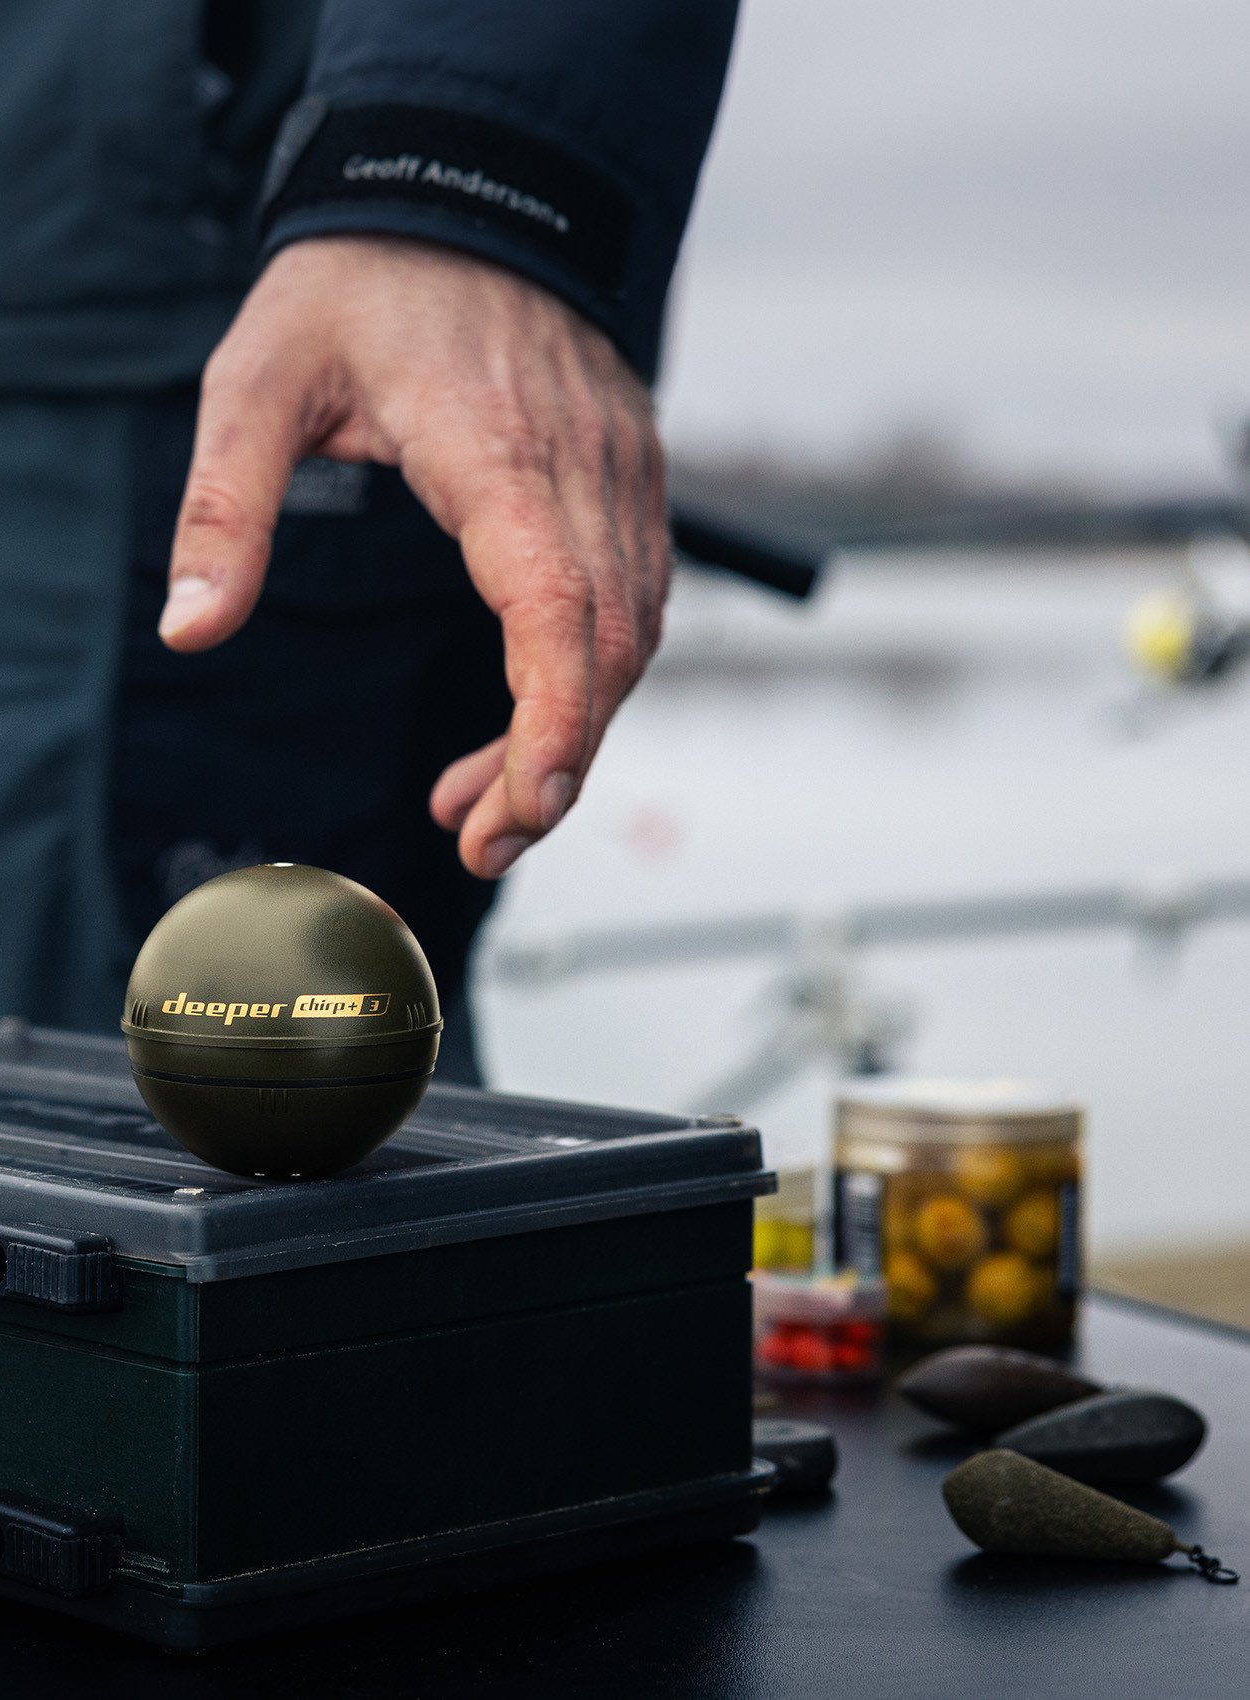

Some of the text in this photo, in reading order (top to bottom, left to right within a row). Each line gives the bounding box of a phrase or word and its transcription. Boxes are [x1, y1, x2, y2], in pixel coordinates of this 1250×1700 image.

[343, 154, 422, 181] Geoff
[162, 992, 380, 1025] deeper chirp+ 3
